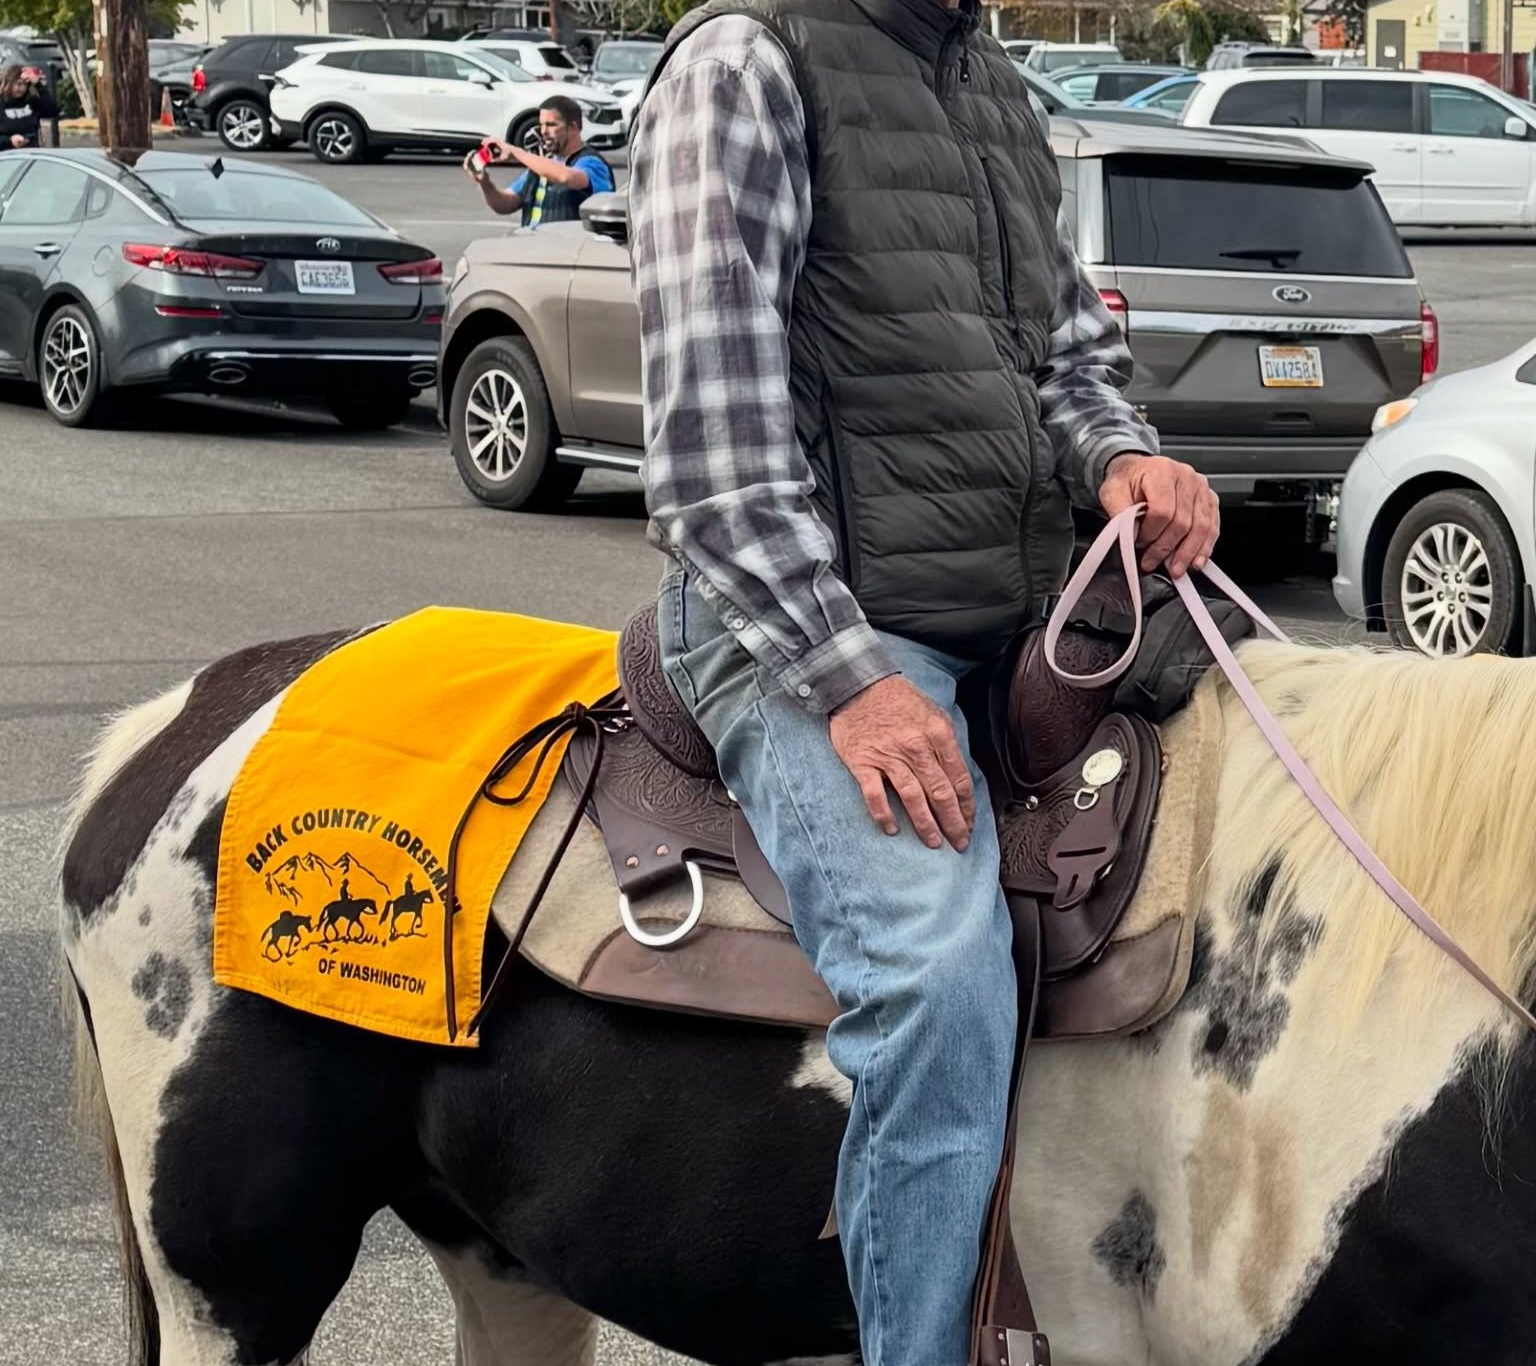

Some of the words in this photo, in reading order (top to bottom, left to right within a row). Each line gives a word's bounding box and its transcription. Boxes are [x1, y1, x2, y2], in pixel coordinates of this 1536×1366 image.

[245, 824, 288, 874] BACK
[291, 808, 383, 835] COUNTRY
[318, 957, 336, 975] OF
[340, 962, 426, 995] WASHINGTON
